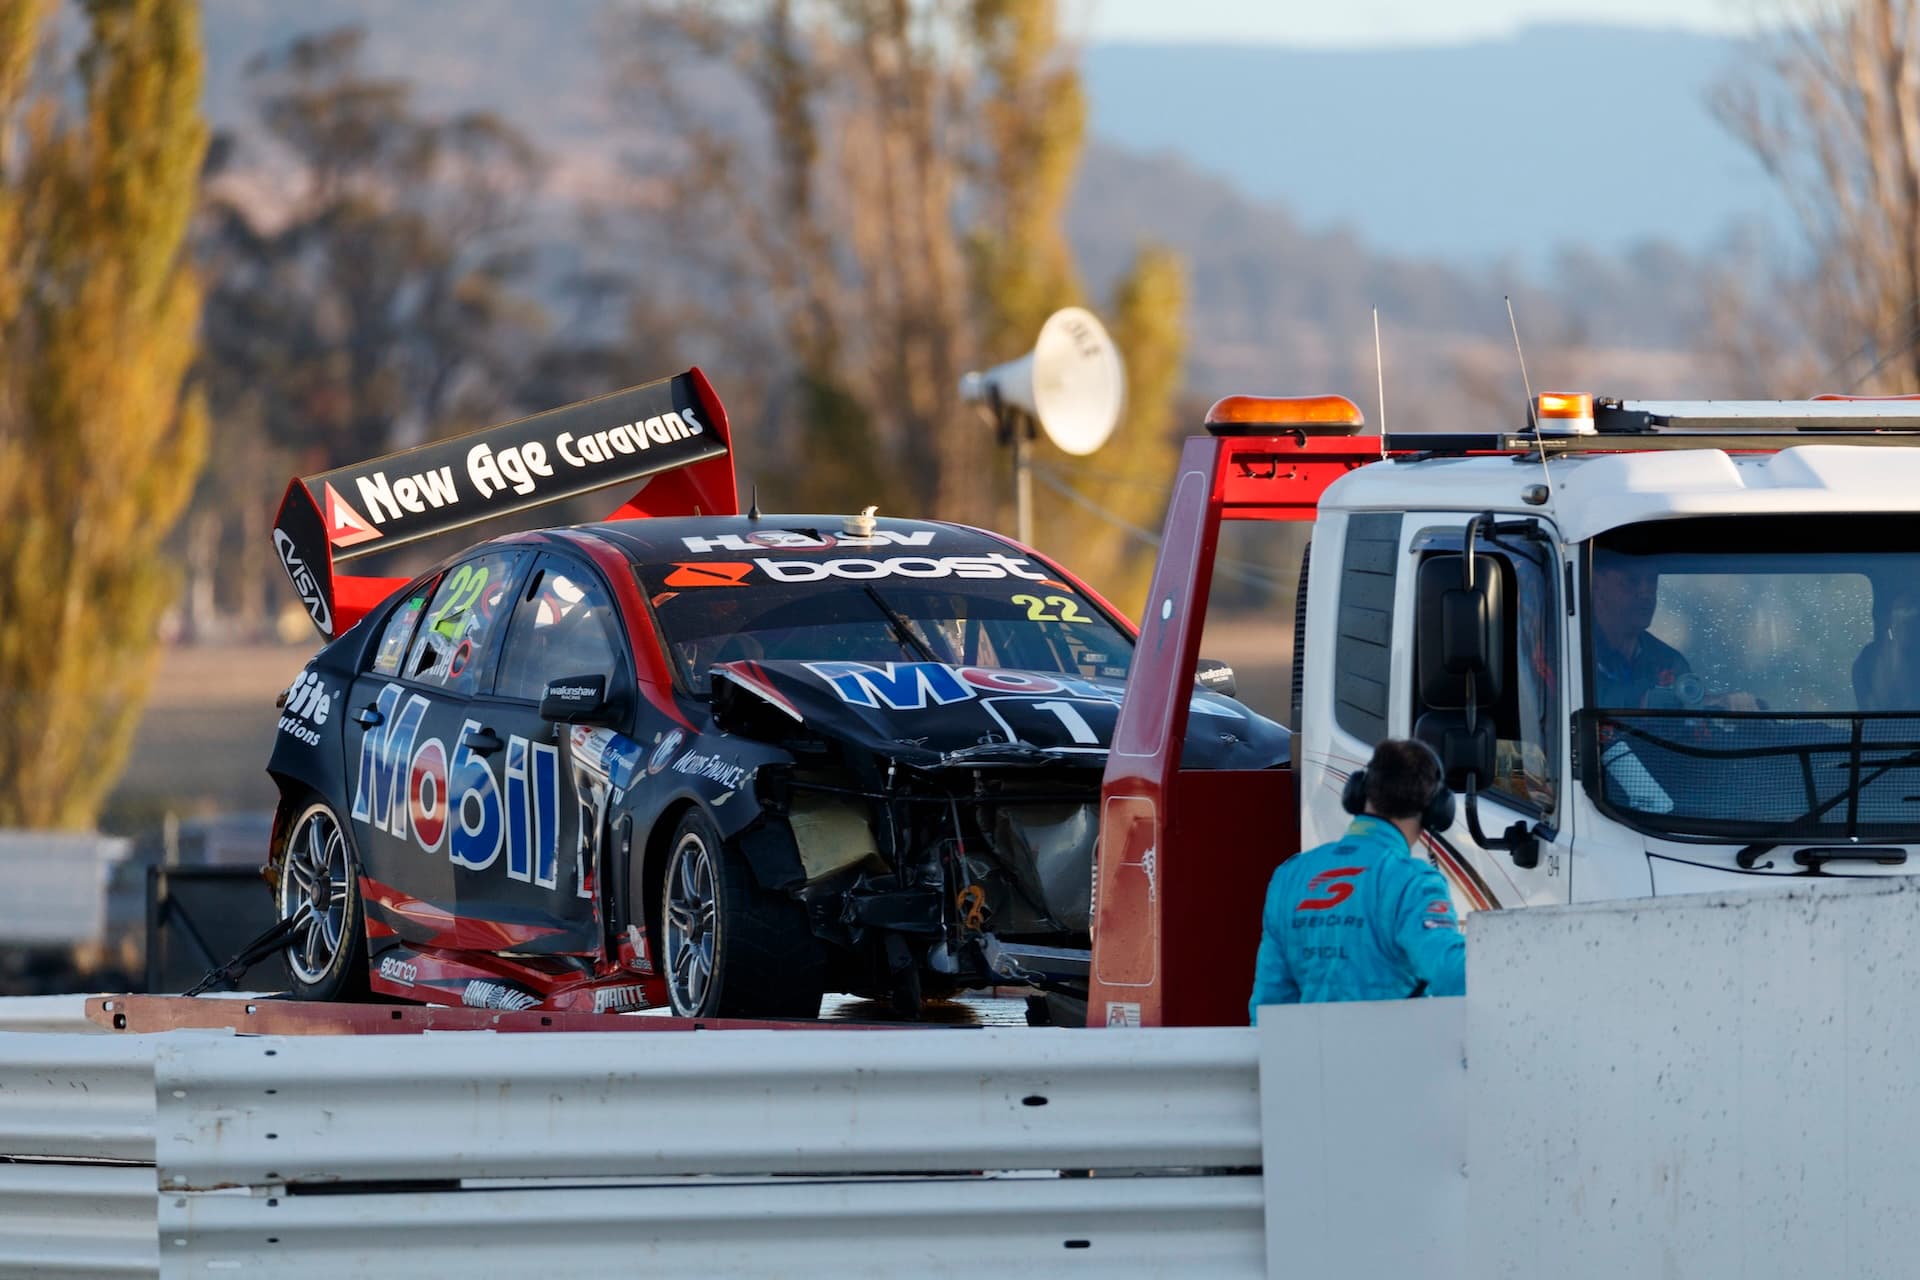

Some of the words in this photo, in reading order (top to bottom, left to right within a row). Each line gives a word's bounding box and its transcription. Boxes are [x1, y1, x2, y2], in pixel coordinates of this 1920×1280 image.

[355, 466, 459, 525] New
[467, 443, 554, 500] Age
[555, 408, 703, 468] Caravans
[753, 552, 1048, 583] boost
[1011, 594, 1093, 624] 22
[351, 682, 560, 890] Mobil
[380, 957, 417, 982] sparco
